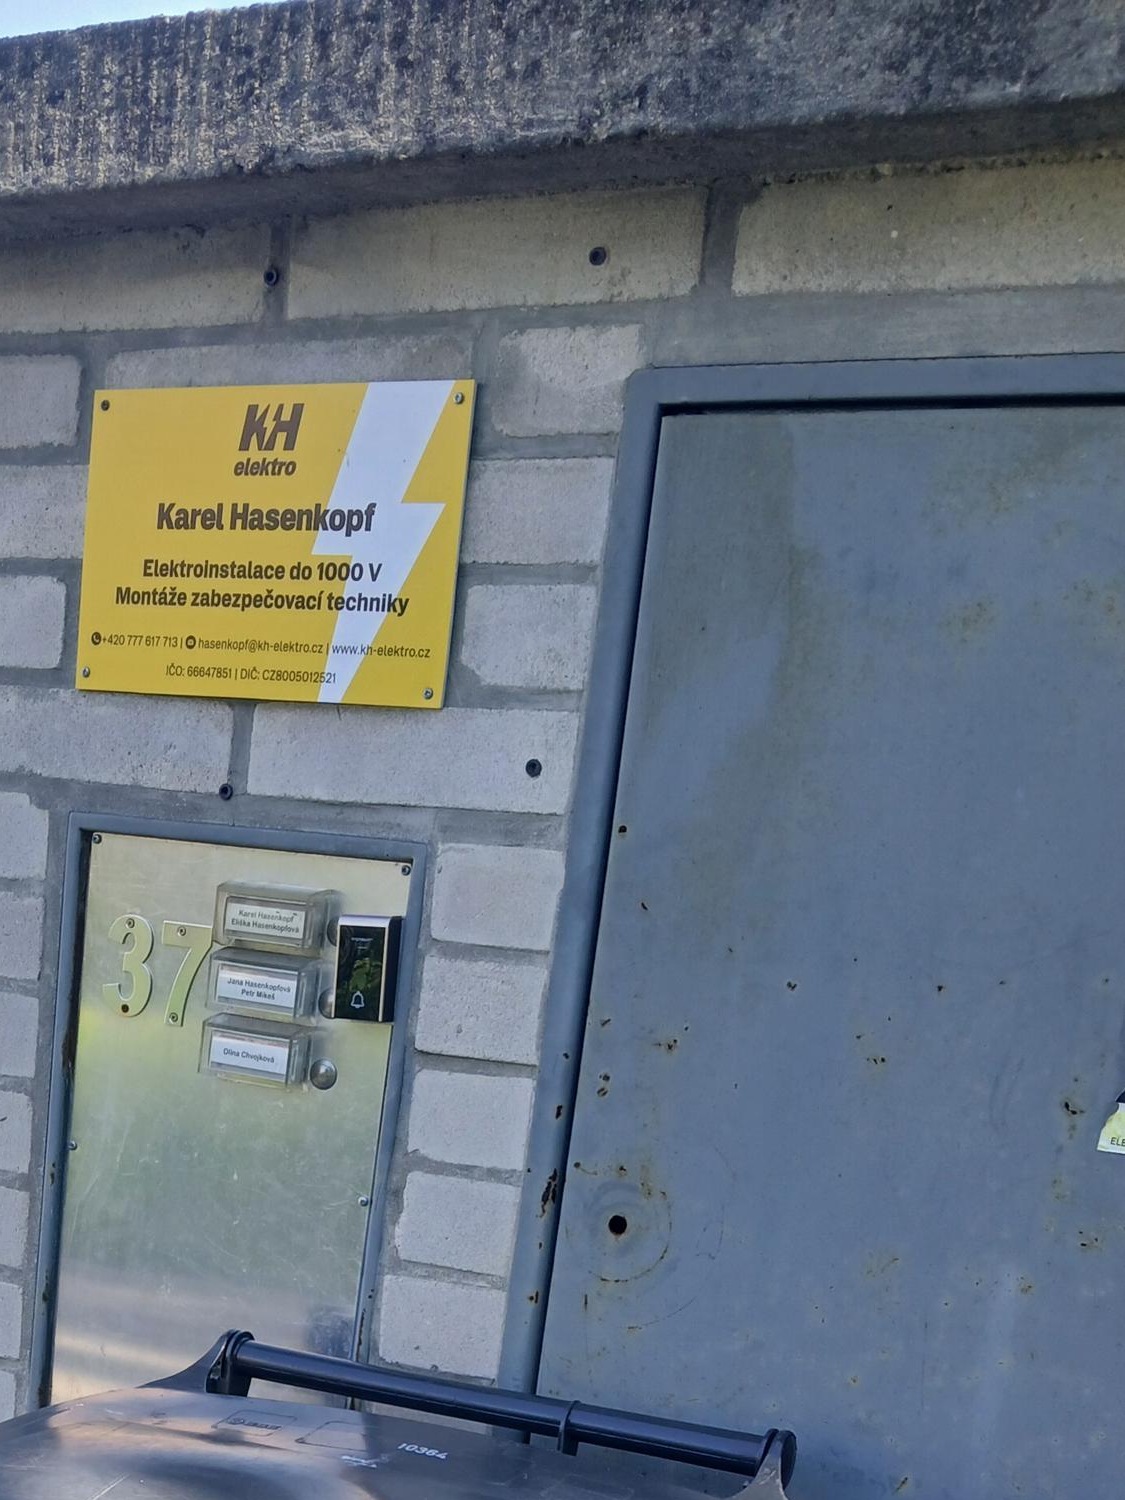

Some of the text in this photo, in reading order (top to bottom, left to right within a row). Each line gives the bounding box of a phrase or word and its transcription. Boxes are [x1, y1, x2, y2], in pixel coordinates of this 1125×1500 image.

[238, 403, 304, 451] KH
[234, 457, 297, 477] elektro
[157, 502, 377, 537] Karel Hasenkopf
[143, 558, 382, 582] Elektroinstalace do 1000 V
[115, 586, 409, 616] Montáže zabezpečovací techniky
[102, 634, 431, 658] +420 777 617 713 hasenkopf@kh-elektro.cz www.kh-elektro.cz
[166, 663, 336, 684] IČO: 66647851 DIČ: CZ8005012521
[102, 913, 214, 1028] 37
[227, 977, 243, 986] Jana
[397, 1443, 448, 1460] 10364
